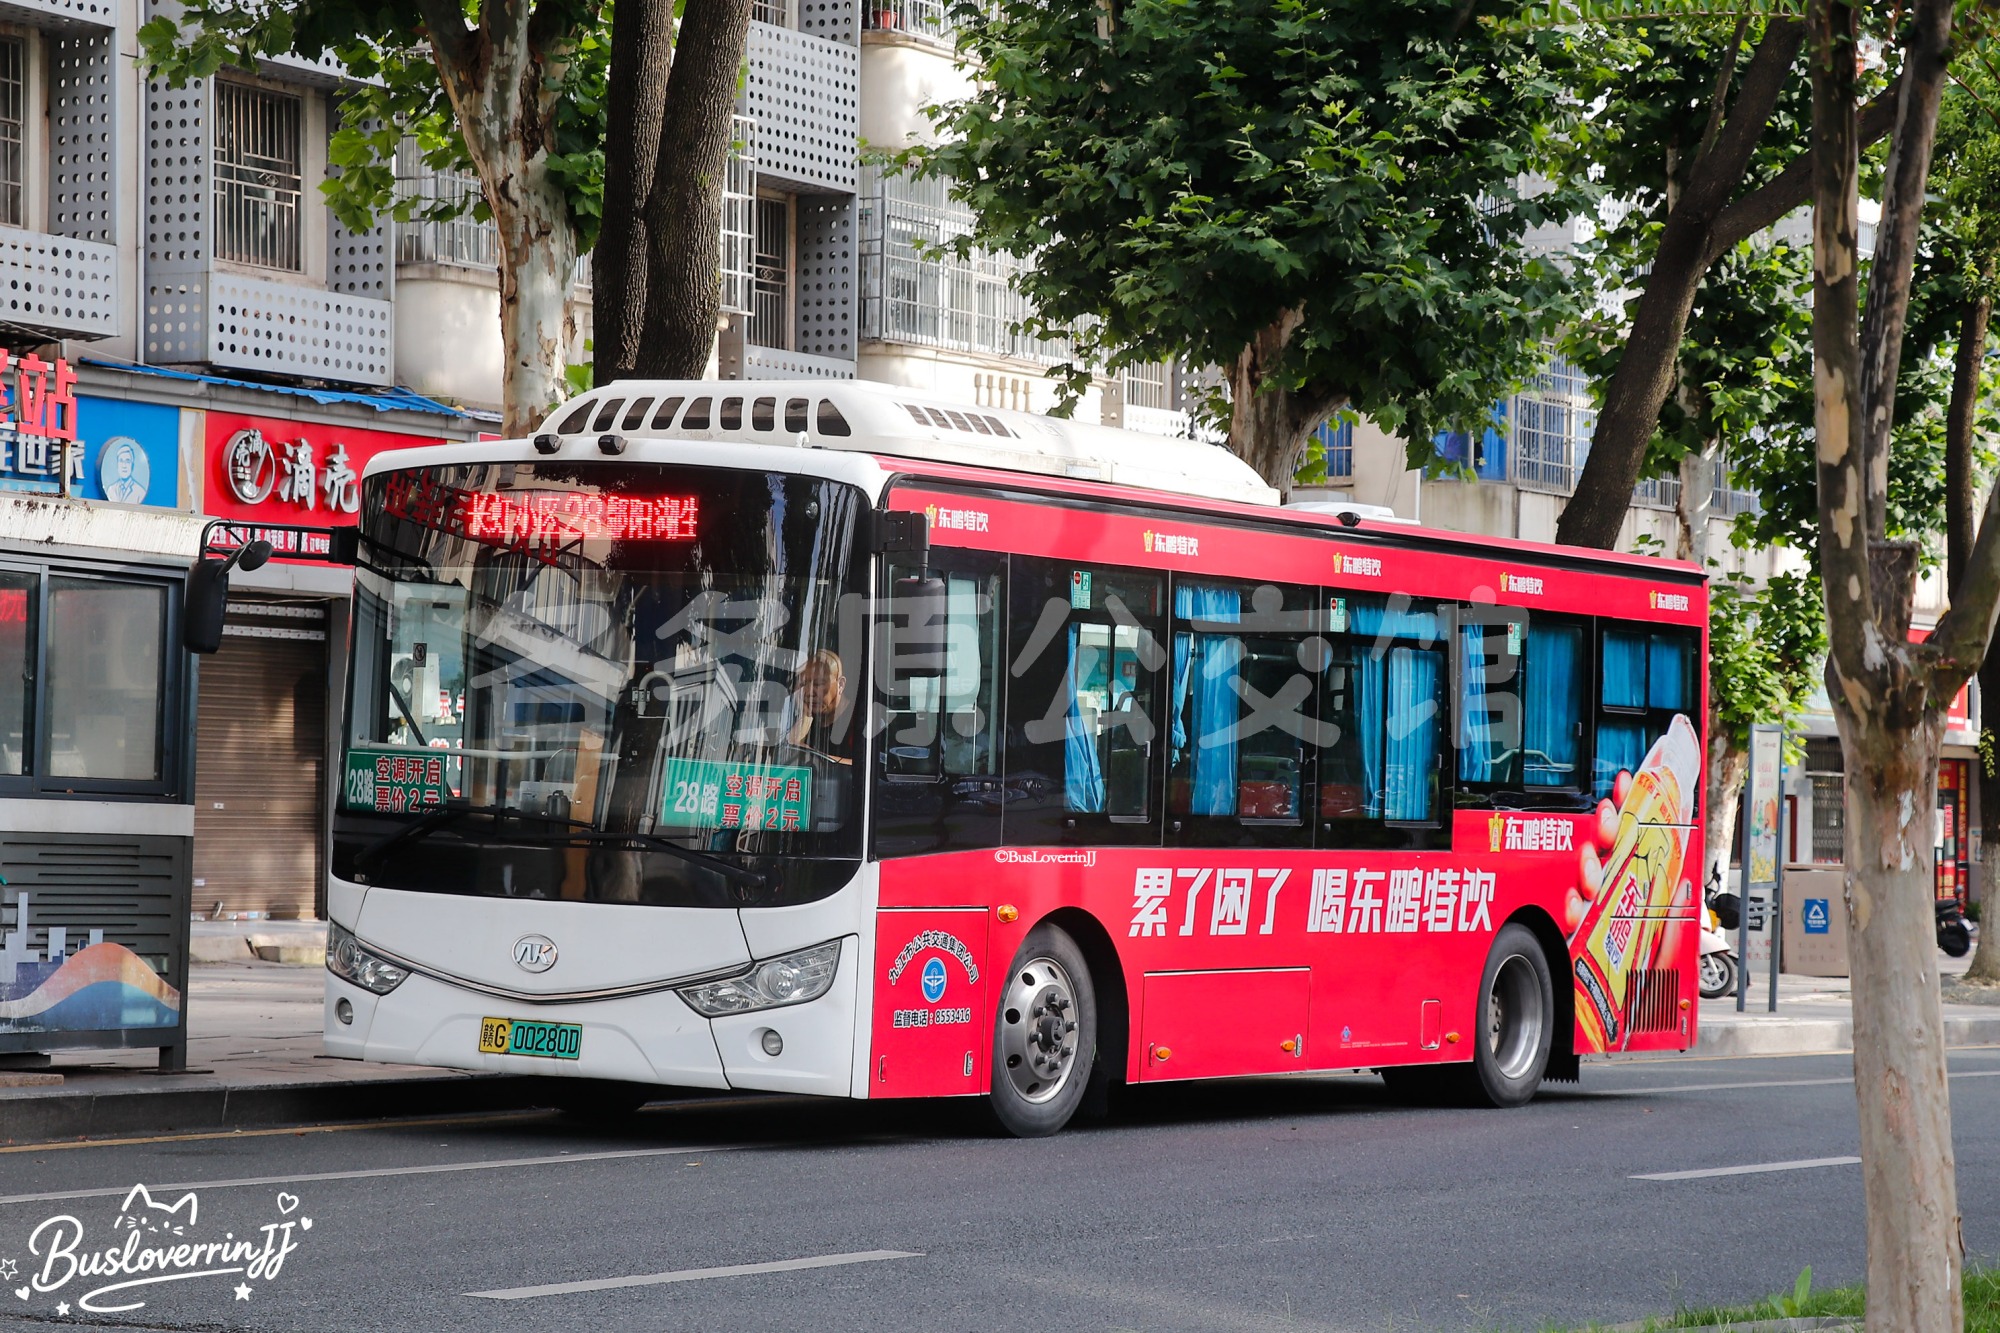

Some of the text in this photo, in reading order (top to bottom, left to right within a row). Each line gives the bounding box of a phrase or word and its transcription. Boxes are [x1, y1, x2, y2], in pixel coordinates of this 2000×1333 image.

[0, 348, 78, 441] 站
[564, 495, 603, 538] 28
[938, 507, 989, 532] 东鹏特饮
[1154, 533, 1199, 556] 东鹏特饮
[1343, 555, 1382, 577] 东鹏特饮
[1508, 573, 1544, 595] 东鹏特饮
[1657, 591, 1689, 612] 东鹏特饮
[375, 756, 442, 786] 空调开启
[349, 768, 374, 806] 28路
[674, 779, 719, 816] 28路
[725, 774, 801, 802] 空调开启
[721, 803, 800, 832] 票价2元
[1505, 816, 1574, 852] 东鹏特饮
[1128, 866, 1496, 937] 累了困了 喝东鹏特饮
[889, 930, 979, 985] 九江市公共交通集团公司
